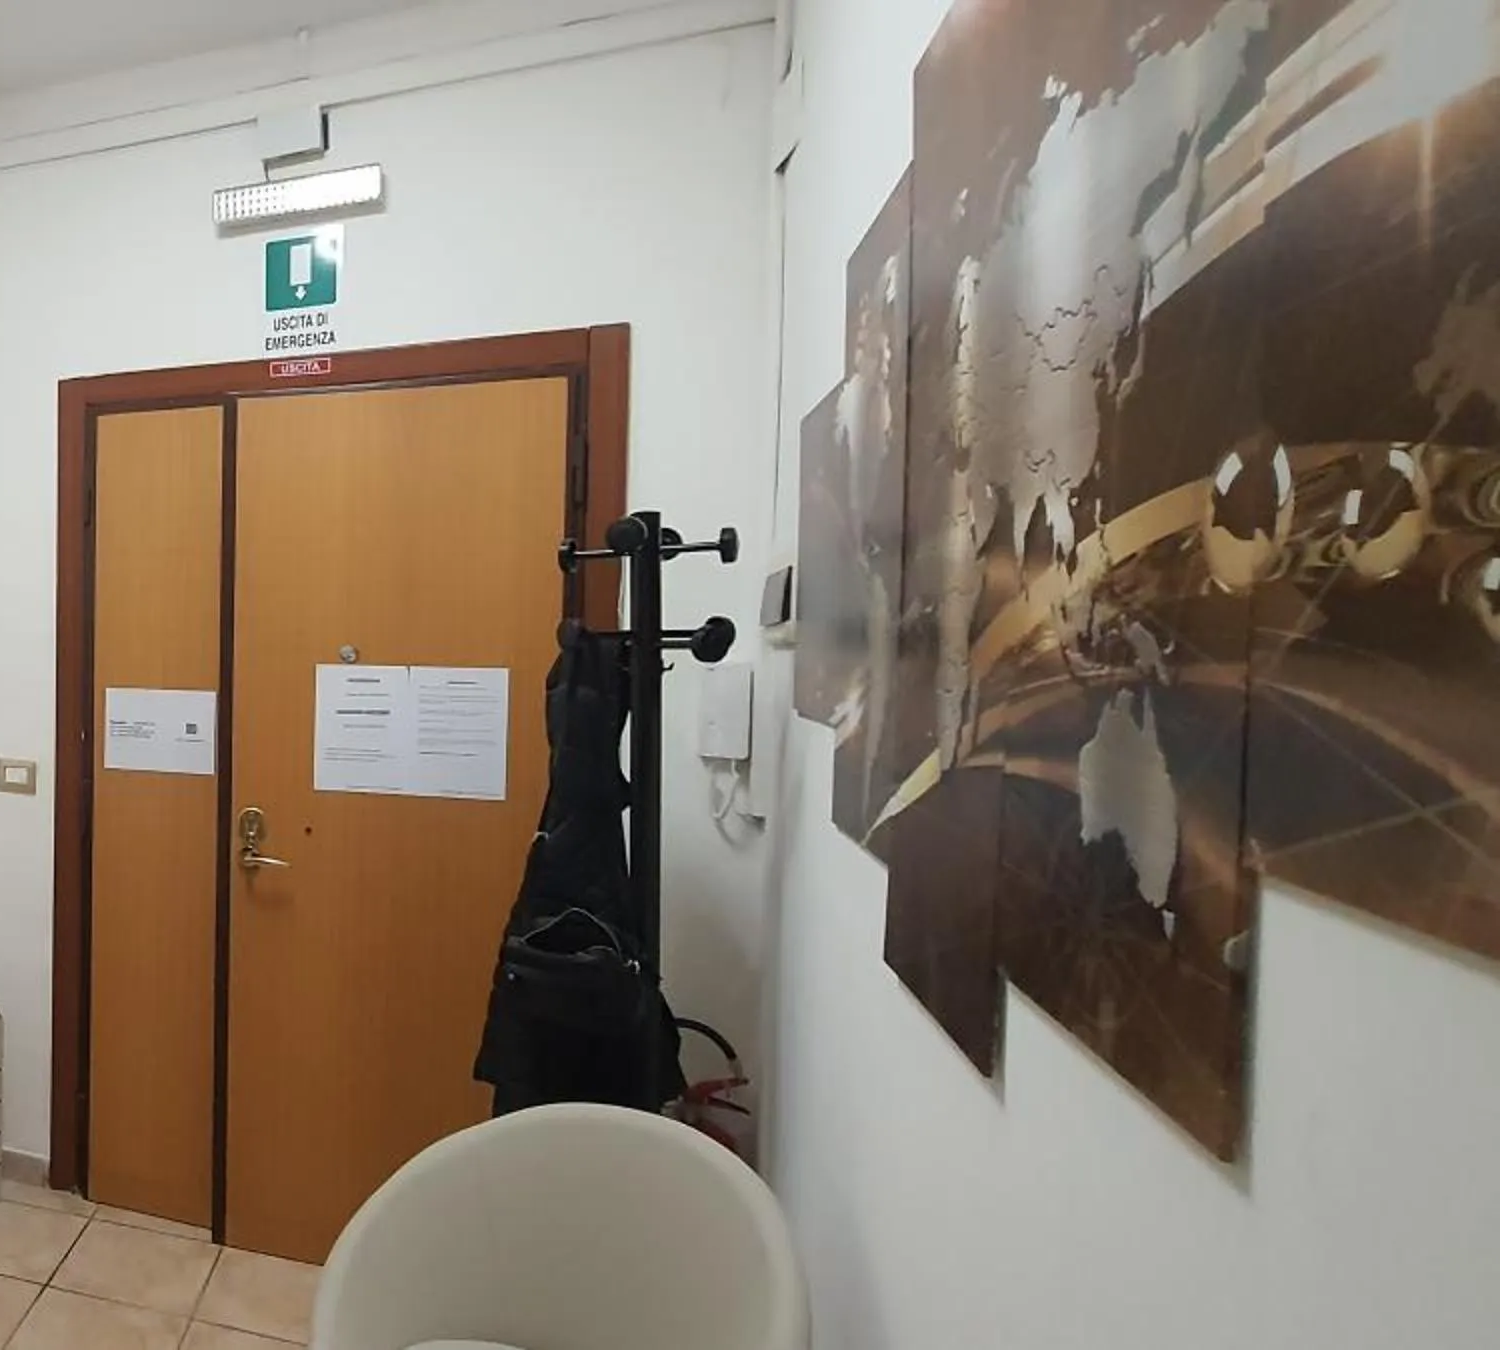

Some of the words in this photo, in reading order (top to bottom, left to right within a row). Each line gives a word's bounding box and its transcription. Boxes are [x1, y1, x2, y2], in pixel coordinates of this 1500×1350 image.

[273, 314, 314, 332] USCITA
[317, 312, 329, 328] DI
[264, 331, 337, 351] EMERGENZA
[280, 362, 321, 374] USCITA
